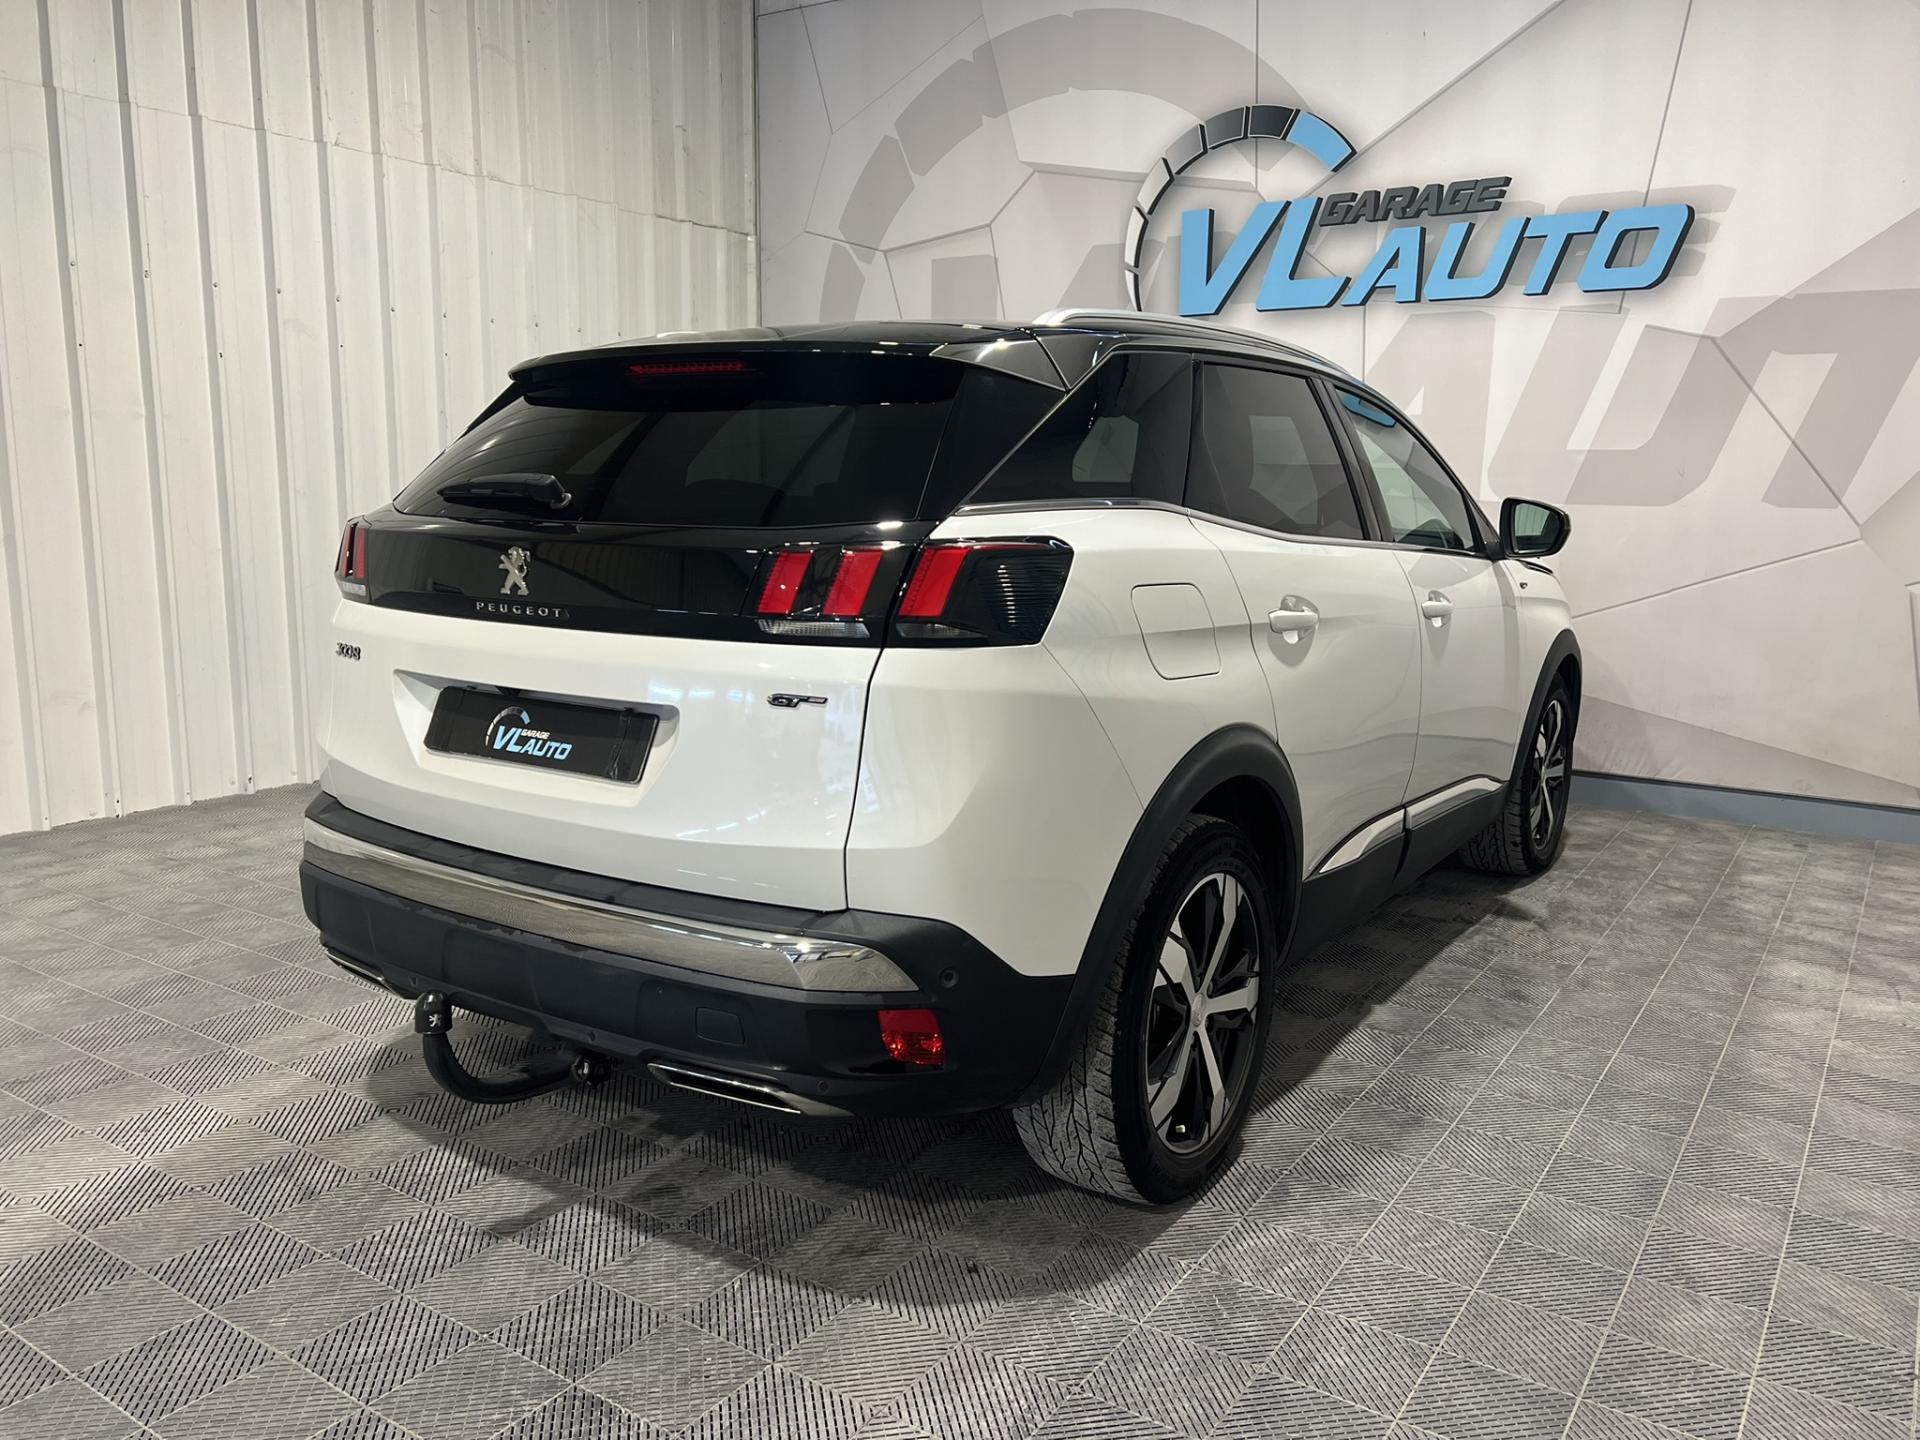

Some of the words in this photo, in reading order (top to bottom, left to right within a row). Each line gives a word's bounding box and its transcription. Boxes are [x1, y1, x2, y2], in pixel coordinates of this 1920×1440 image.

[1319, 176, 1512, 226] GARAGE
[476, 601, 561, 618] PEUGEOT
[520, 728, 551, 740] GARAGE
